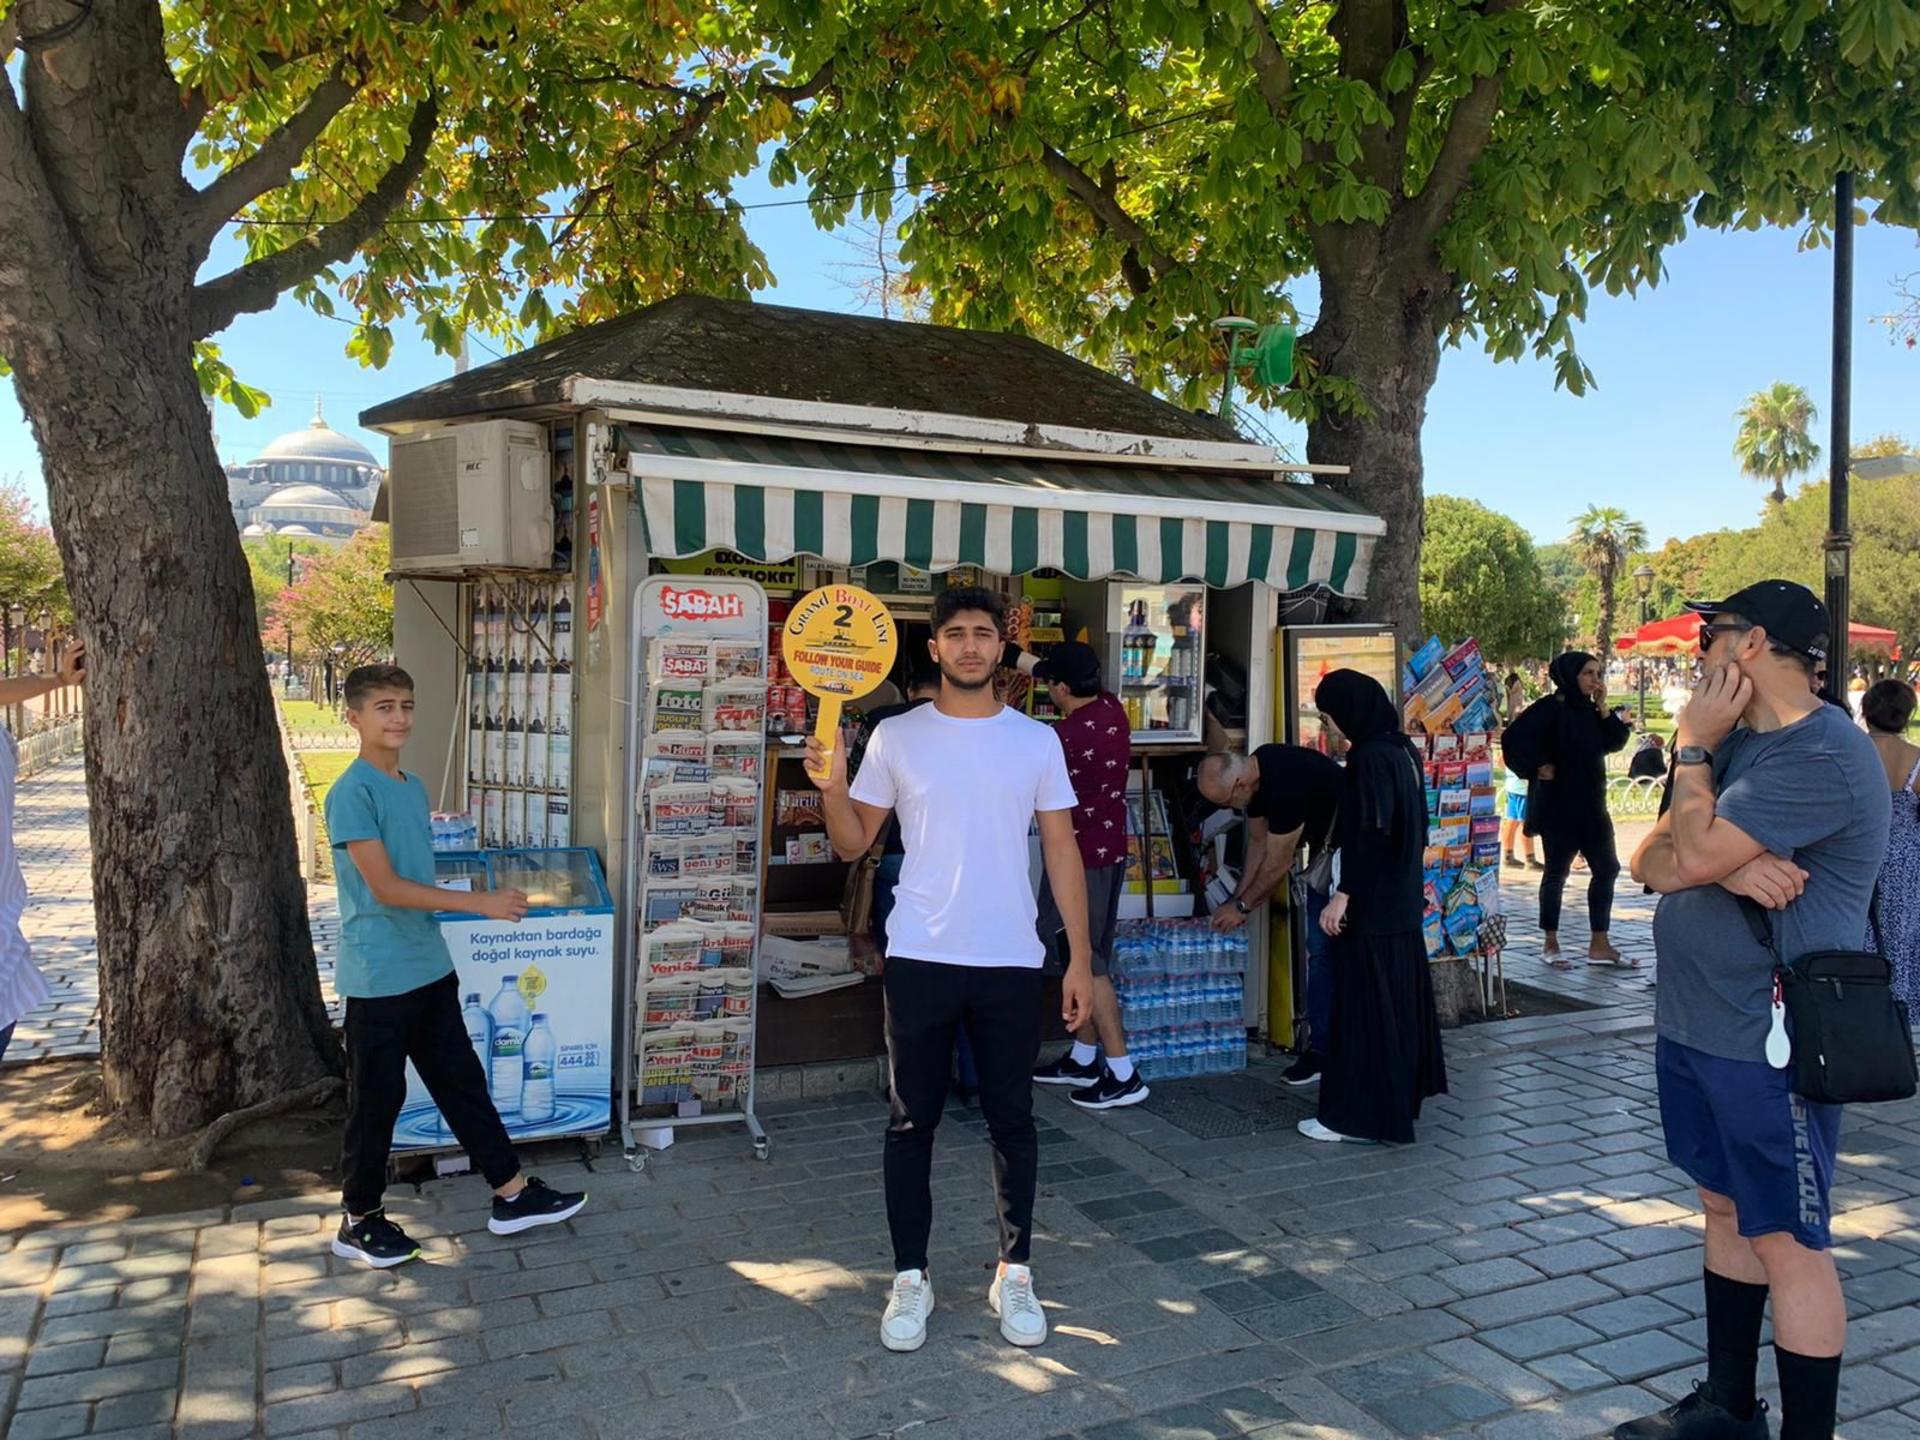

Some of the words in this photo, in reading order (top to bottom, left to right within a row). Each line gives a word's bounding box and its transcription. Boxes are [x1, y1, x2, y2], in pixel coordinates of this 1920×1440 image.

[664, 591, 739, 615] SABAH
[833, 604, 853, 628] 2
[793, 650, 828, 667] FOLLOW
[830, 655, 855, 670] YOUR
[855, 659, 883, 674] GUIDE
[470, 932, 542, 946] Kaynaktan
[546, 926, 602, 943] bardağa
[472, 950, 511, 964] doğal
[514, 945, 562, 960] kaynak
[565, 945, 599, 959] suyu.
[560, 1055, 583, 1065] 444
[1795, 1152, 1821, 1227] NICOLE
